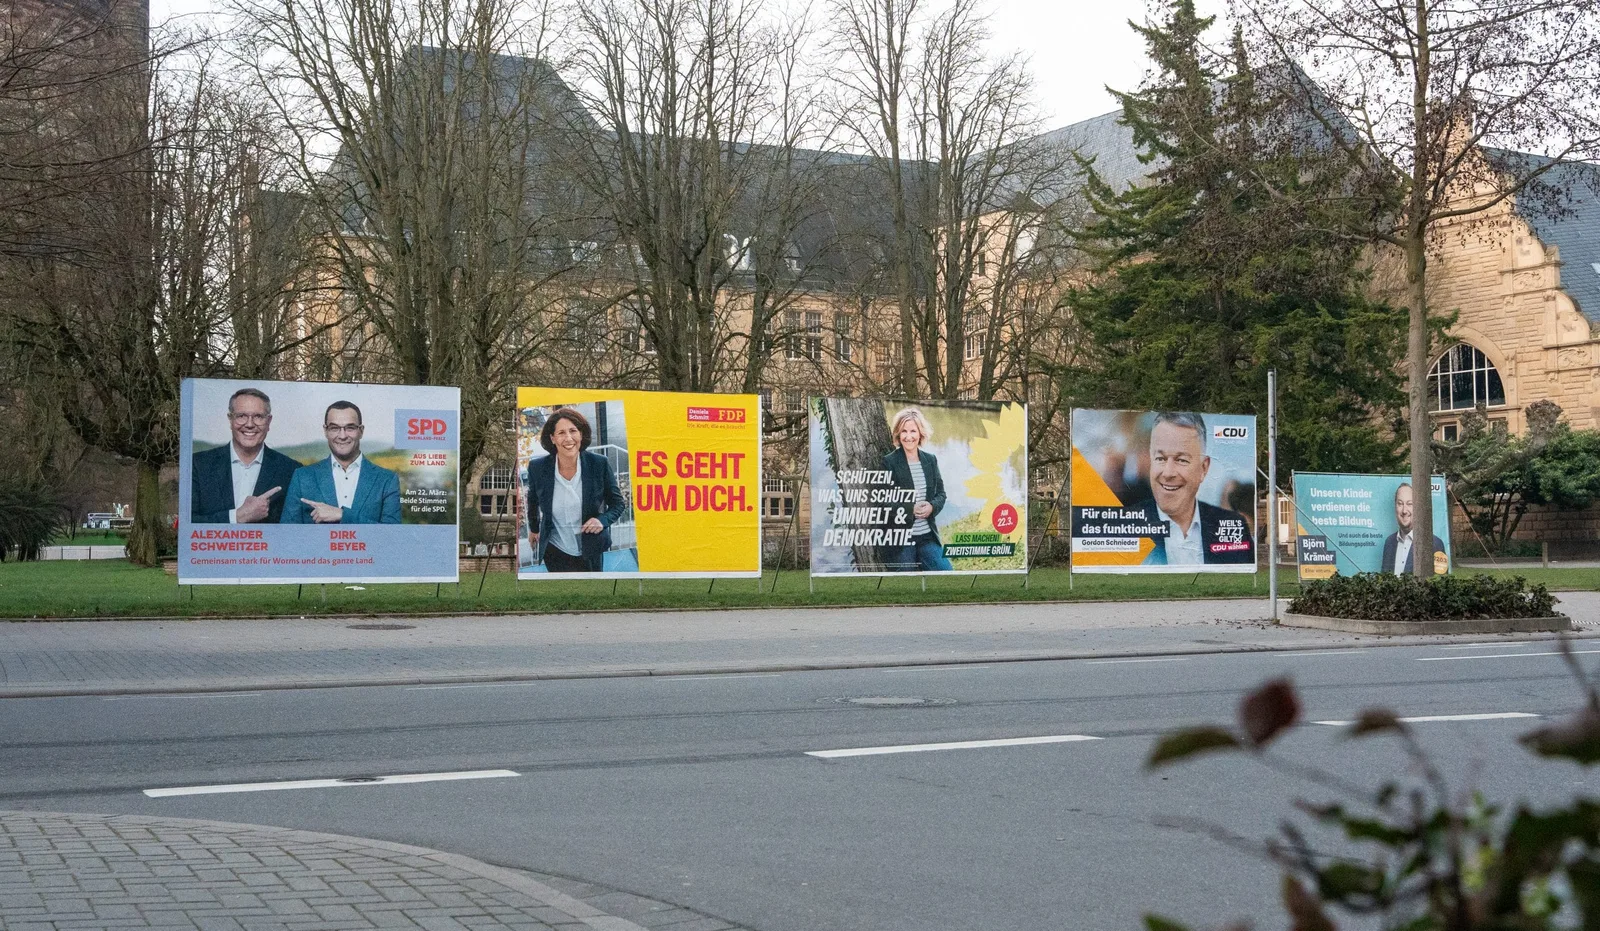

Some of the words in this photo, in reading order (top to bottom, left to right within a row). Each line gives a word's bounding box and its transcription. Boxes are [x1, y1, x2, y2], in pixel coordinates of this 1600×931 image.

[718, 409, 744, 421] FDP
[407, 418, 447, 436] SPD
[1222, 427, 1246, 438] CDU
[636, 451, 668, 479] ES
[675, 452, 746, 480] GEHT
[836, 468, 895, 486] SCHÜTZEN,
[818, 488, 844, 503] WAS
[845, 488, 869, 503] UNS
[1310, 487, 1341, 498] Unsere
[1343, 488, 1373, 498] Kinder
[400, 496, 418, 504] Beide
[636, 484, 678, 512] UM
[684, 485, 754, 513] DICH.
[411, 505, 421, 513] für
[422, 505, 432, 513] die
[432, 505, 447, 513] SPD.
[1311, 502, 1356, 512] verdienen
[1357, 502, 1371, 512] die
[832, 506, 892, 525] UMWELT
[894, 506, 908, 525] &
[1001, 509, 1009, 517] AM
[1082, 508, 1100, 519] Für
[1101, 508, 1118, 519] ein
[1119, 509, 1148, 522] Land,
[997, 516, 1014, 528] 22.3.
[1219, 519, 1242, 527] WEIL'S
[1312, 516, 1338, 526] beste
[1339, 516, 1375, 528] Bildung.
[191, 530, 263, 539] ALEXANDER
[1082, 523, 1101, 535] das
[1103, 523, 1168, 535] funktioniert.
[1215, 526, 1244, 536] JETZT
[330, 530, 357, 540] DIRK
[823, 528, 916, 547] DEMOKRATIE.
[955, 534, 971, 543] LASS
[972, 533, 1000, 542] MACHEN!
[191, 542, 268, 551] SCHWEITZER
[330, 542, 366, 551] BEYER
[1303, 538, 1325, 550] Björn
[945, 546, 991, 556] ZWEITSTIMME
[992, 544, 1012, 555] GRÜN.
[191, 557, 237, 565] Gemeinsam
[239, 557, 258, 565] stark
[260, 557, 271, 565] für
[273, 557, 300, 565] Worms
[302, 557, 316, 565] und
[318, 557, 330, 565] das
[332, 558, 354, 567] ganze
[356, 557, 375, 565] Land.
[1303, 551, 1334, 562] Krämer
